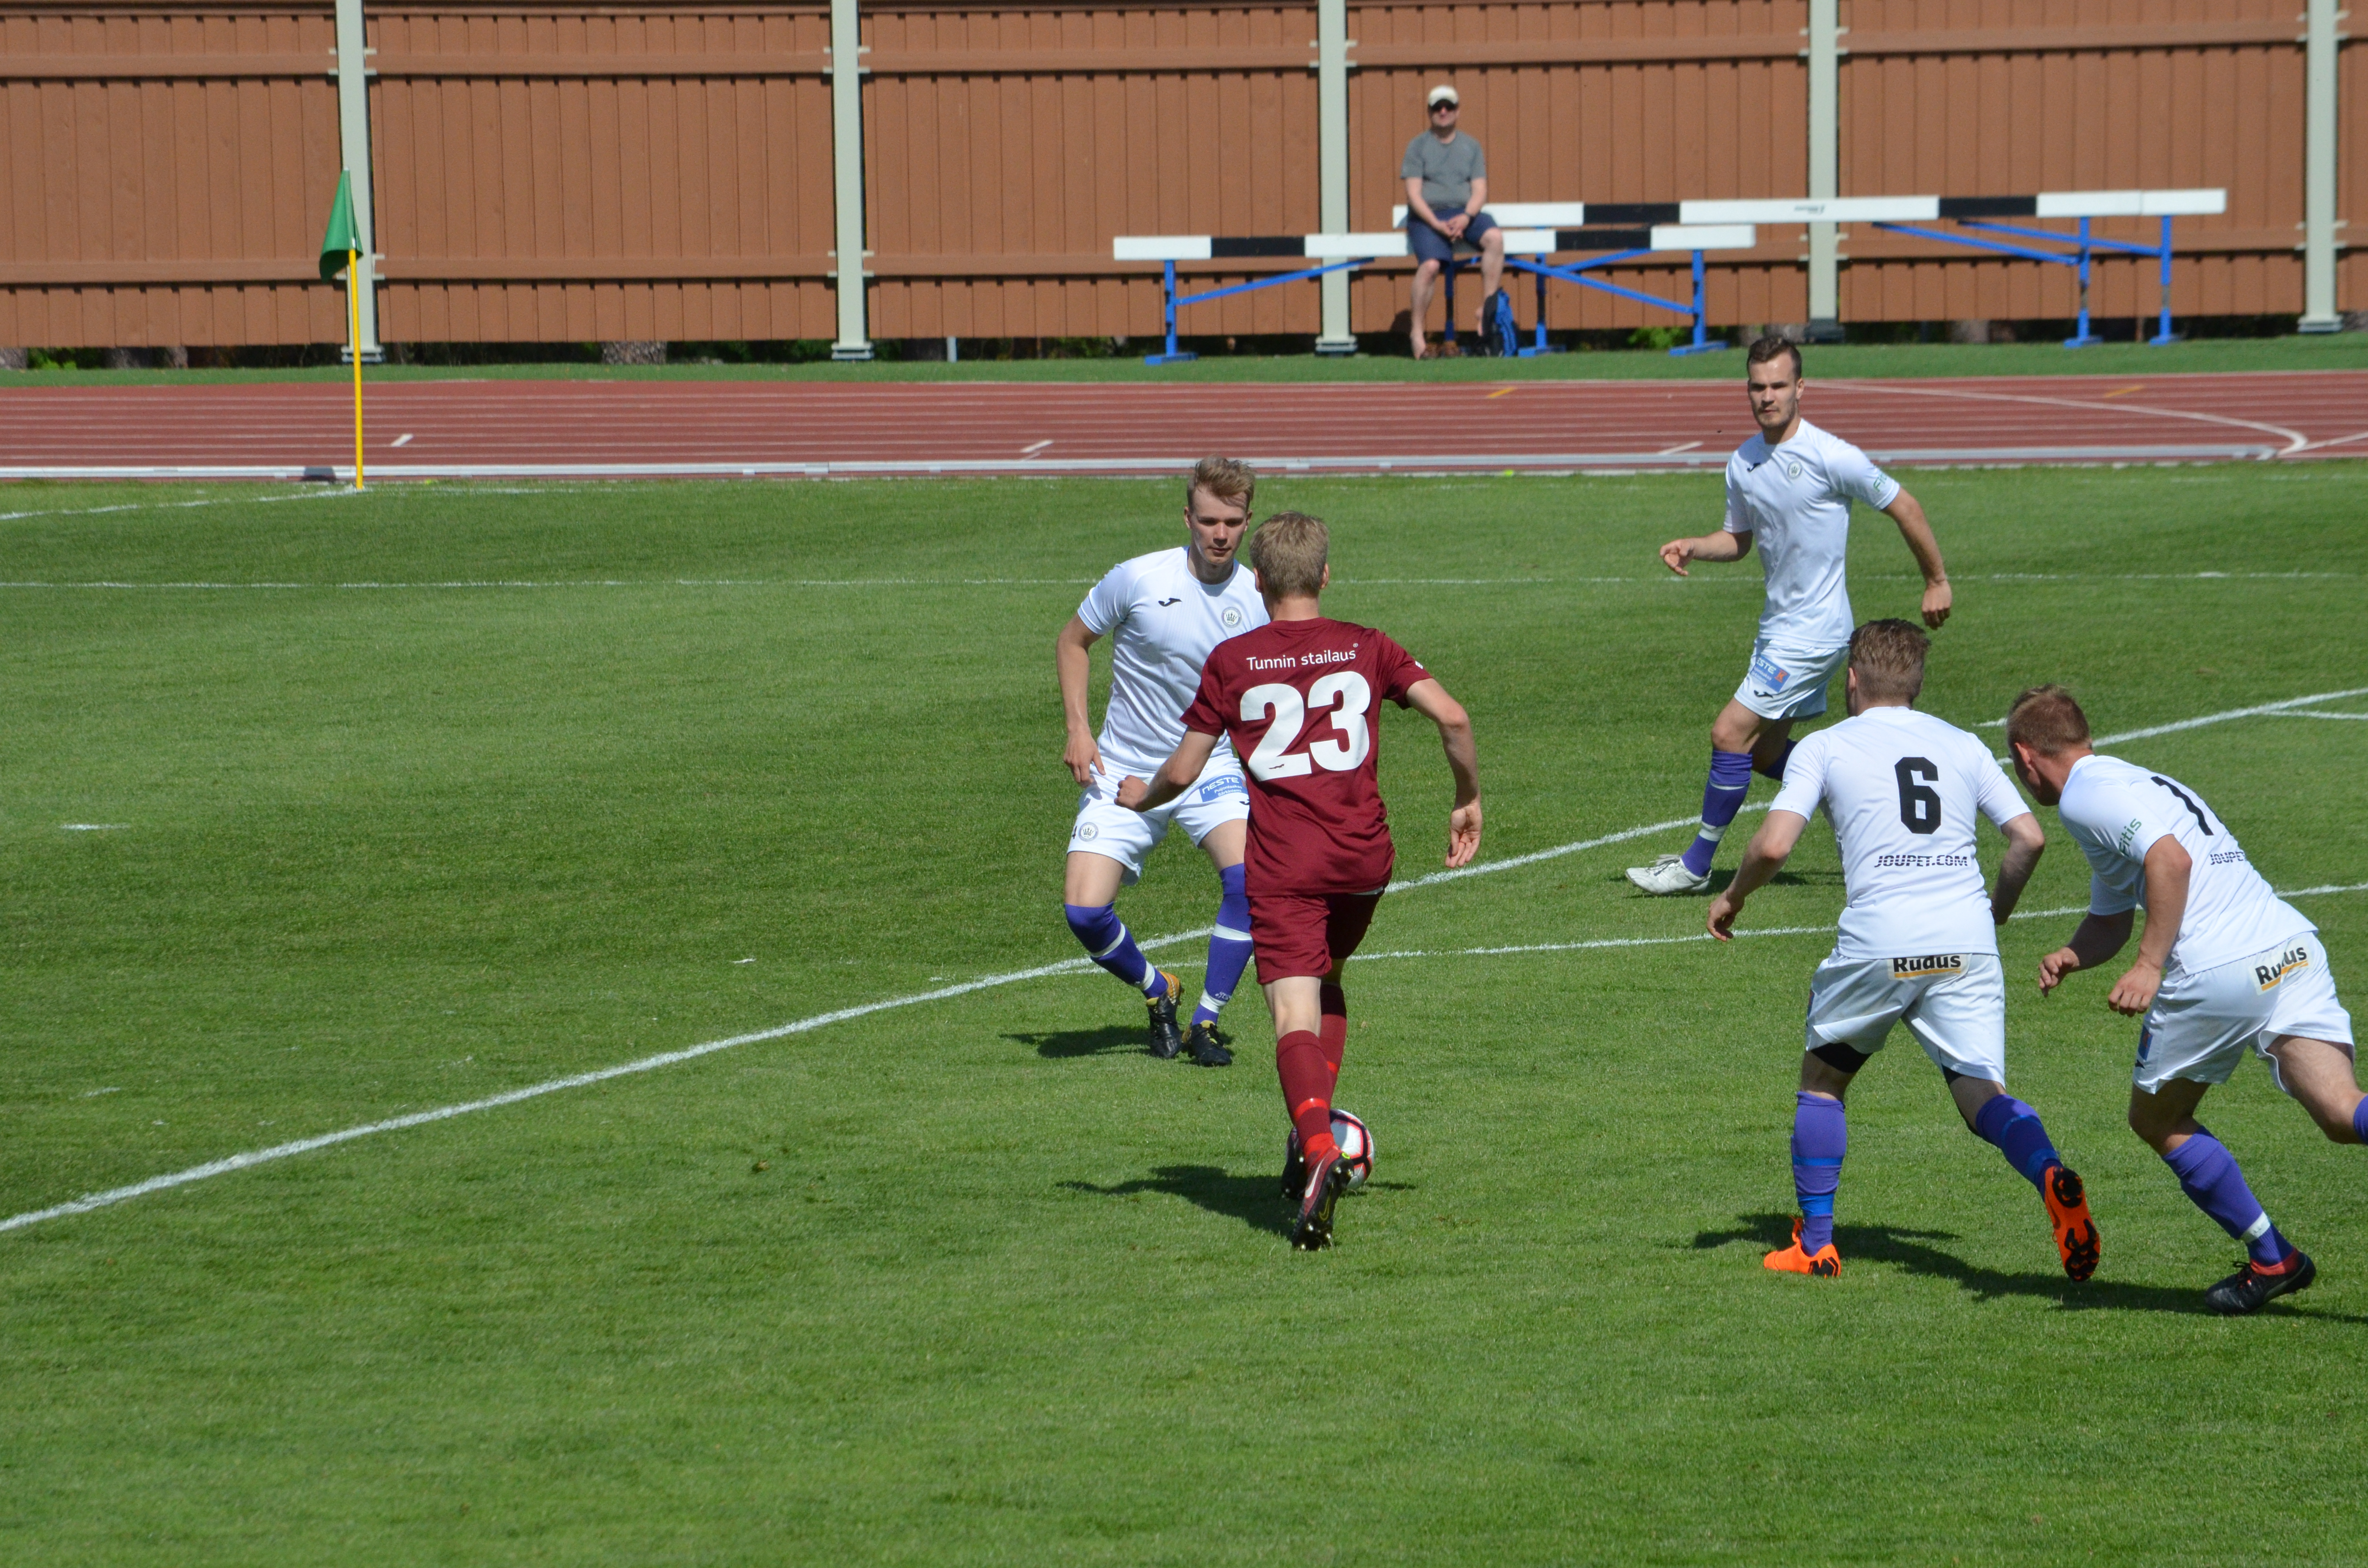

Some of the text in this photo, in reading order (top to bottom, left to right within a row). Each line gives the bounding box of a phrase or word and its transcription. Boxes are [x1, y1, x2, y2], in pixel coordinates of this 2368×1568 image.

[1246, 649, 1356, 671] Tunnin stailaus
[1240, 671, 1371, 782] 23
[1202, 777, 1240, 795] NESTE
[1894, 757, 1942, 835] 6
[2150, 776, 2232, 836] 1
[2118, 818, 2142, 858] Fitis
[1874, 855, 1968, 868] JOUPET.COM
[1893, 955, 1961, 973] Rudus
[2255, 947, 2307, 986] Ruus
